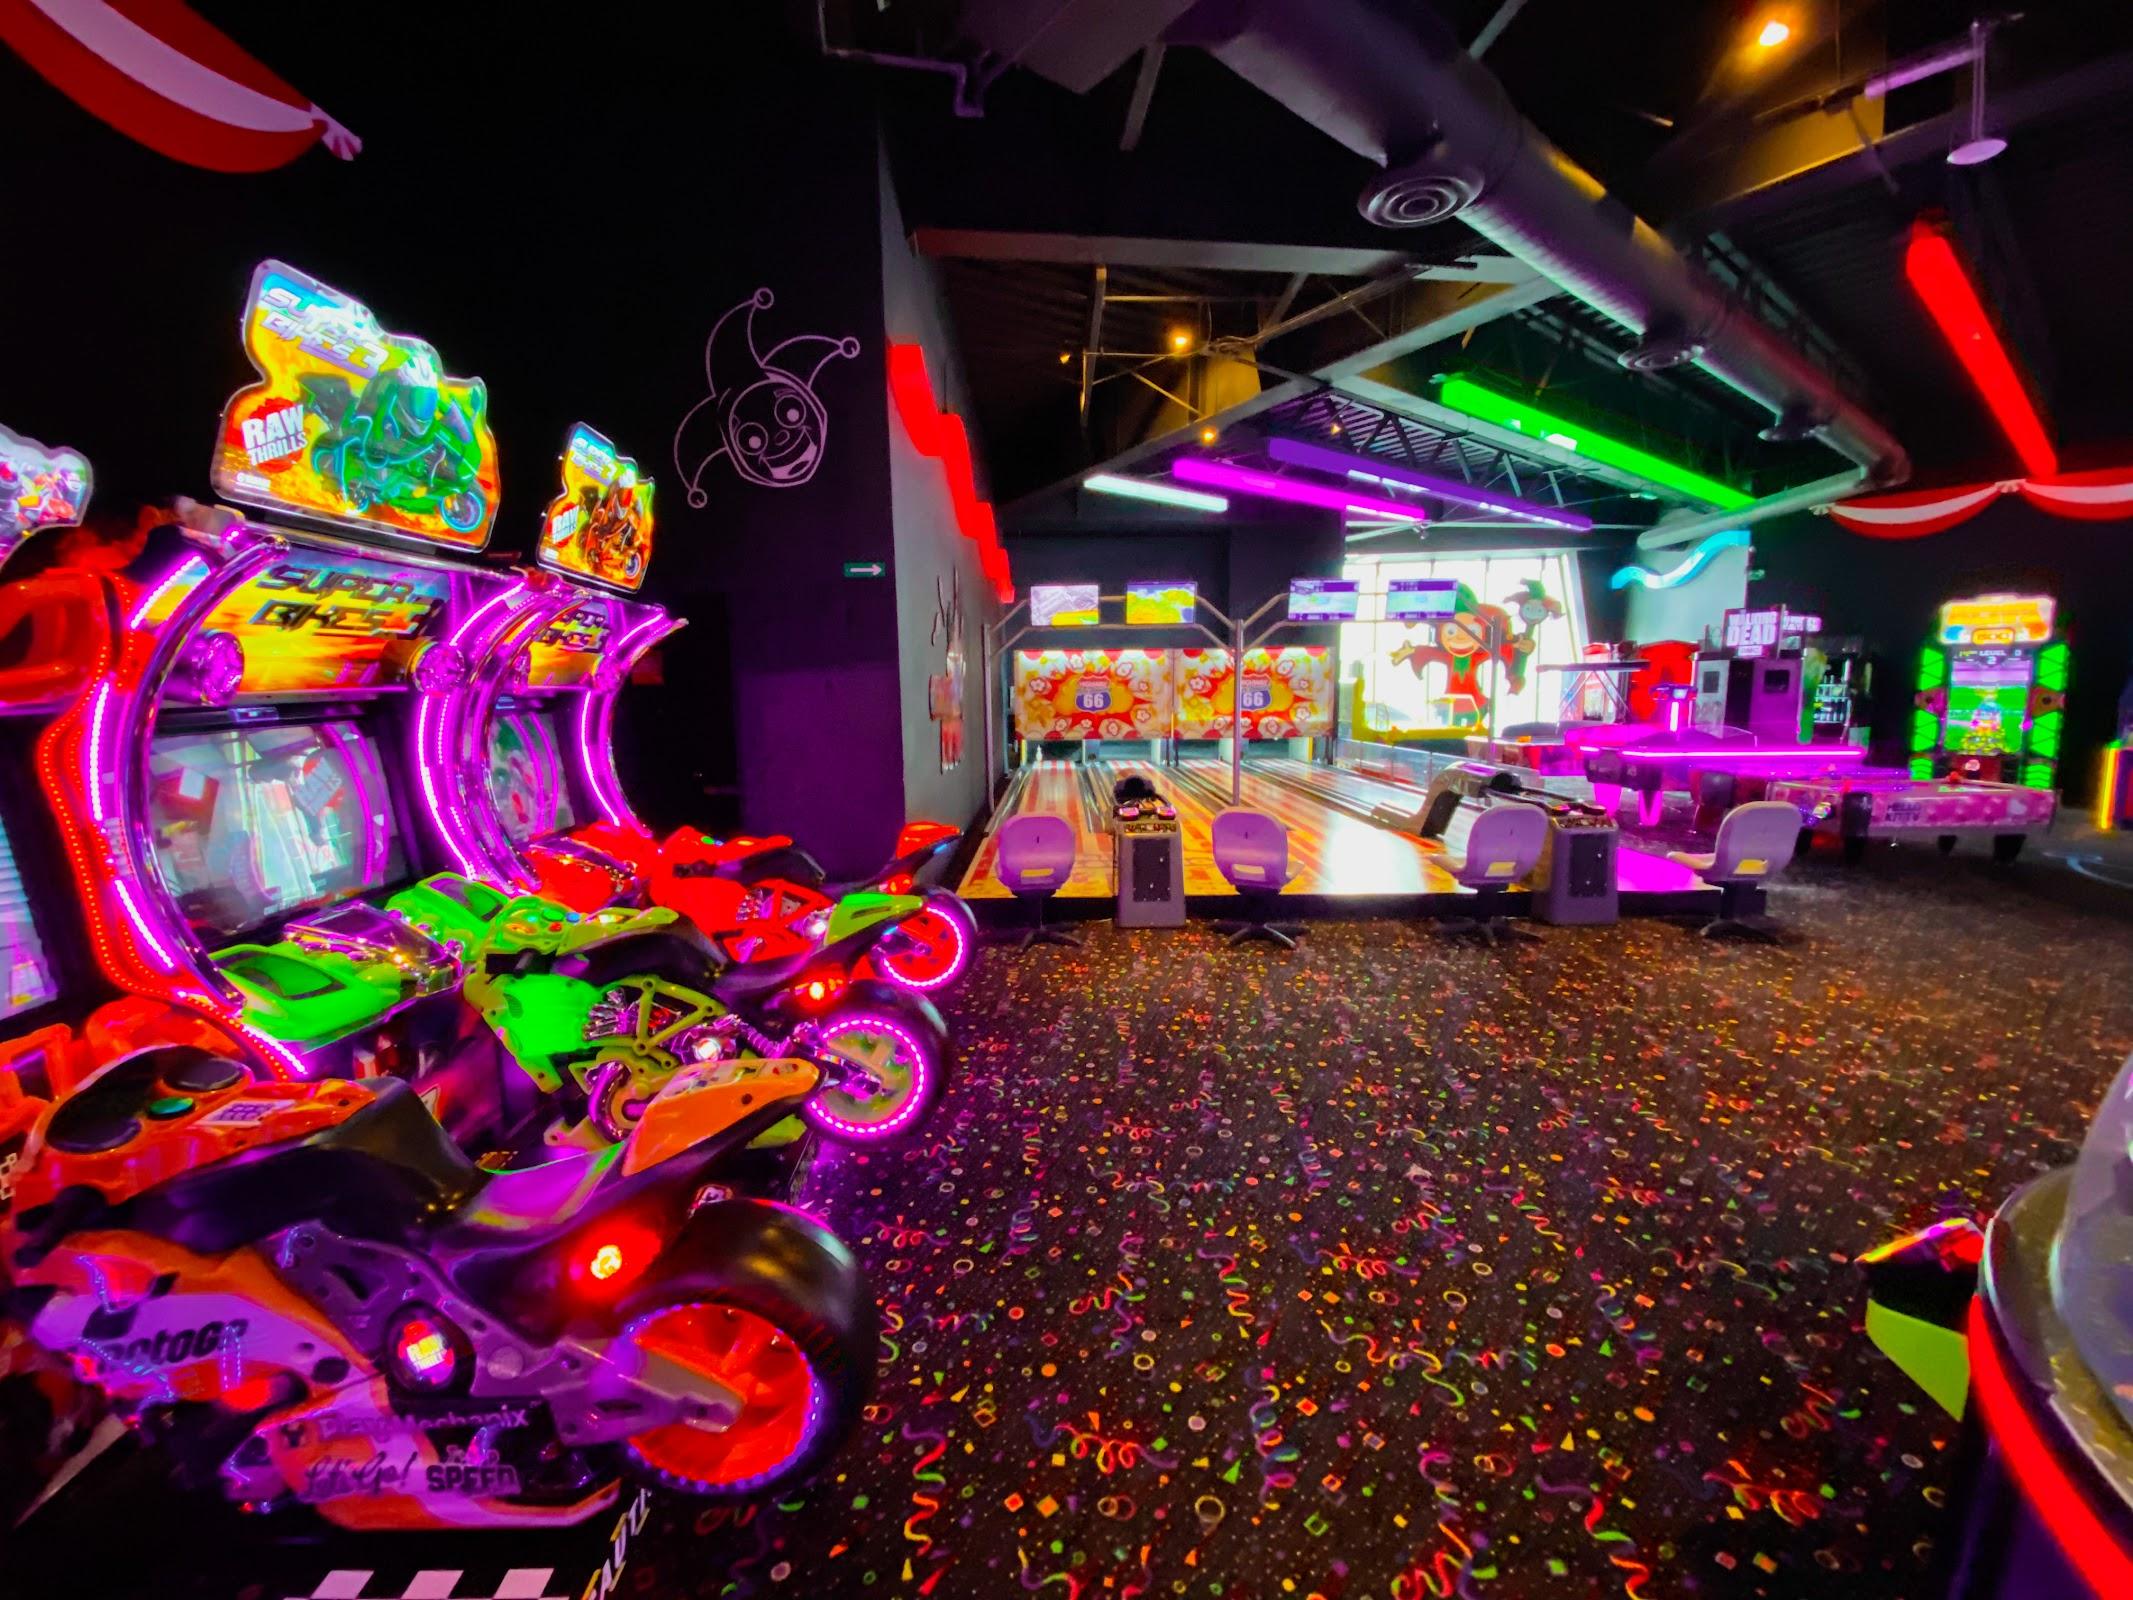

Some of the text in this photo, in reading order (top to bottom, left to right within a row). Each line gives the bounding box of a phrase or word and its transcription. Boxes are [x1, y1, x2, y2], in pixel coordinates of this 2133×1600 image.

[242, 404, 304, 452] RAW
[248, 432, 308, 466] THRILLS
[1726, 623, 1776, 646] DEAD
[1083, 693, 1104, 709] 66
[1242, 691, 1264, 708] 66
[425, 1464, 520, 1494] SPEED
